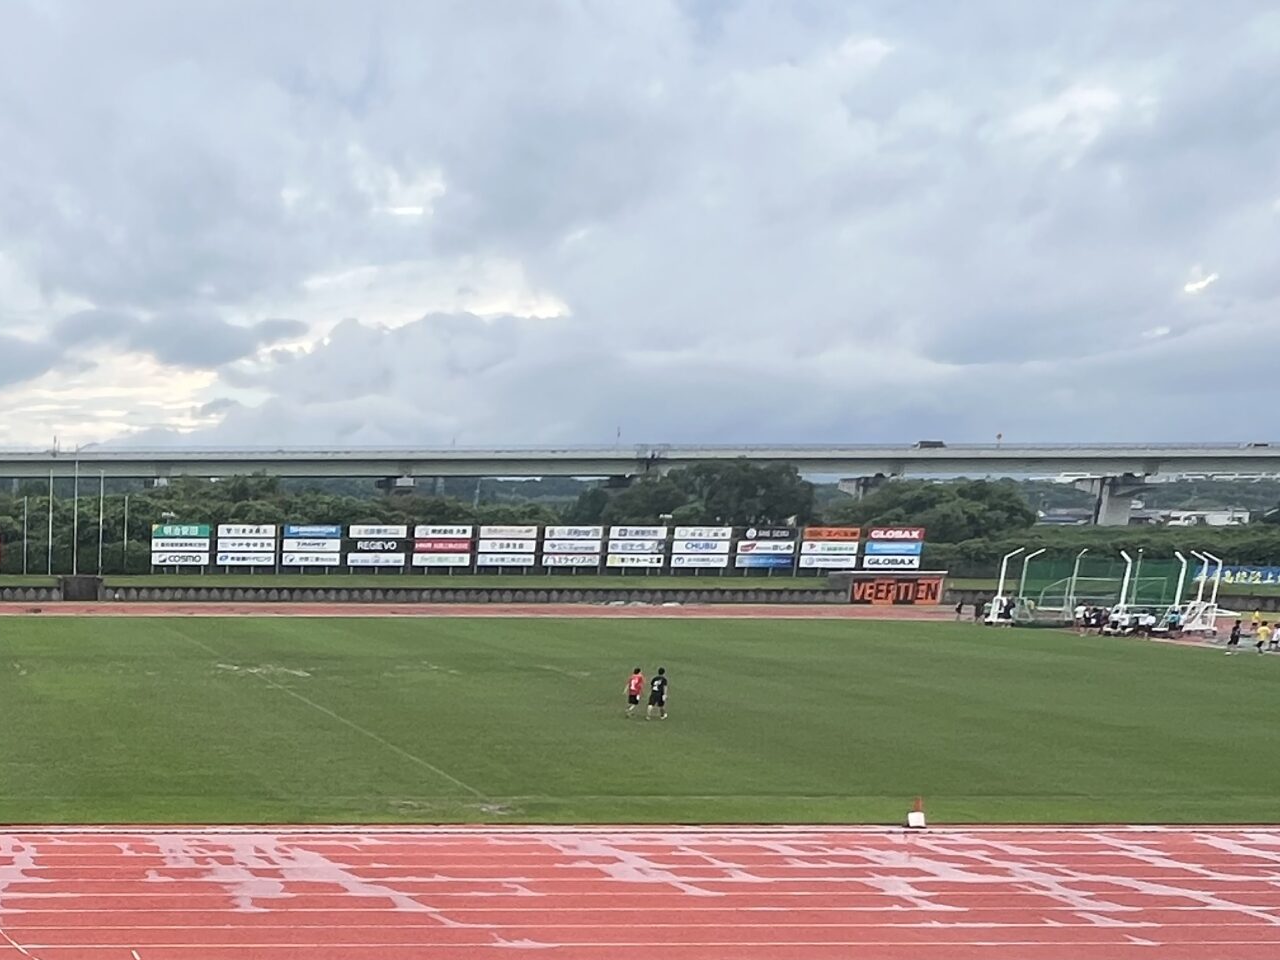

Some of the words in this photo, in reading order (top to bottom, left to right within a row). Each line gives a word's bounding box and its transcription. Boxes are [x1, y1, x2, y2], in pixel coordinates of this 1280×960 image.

[871, 530, 921, 539] GLOBAX
[685, 542, 718, 550] CHUBU
[868, 558, 915, 566] GLOBAX
[853, 581, 939, 601] VEERTIEN
